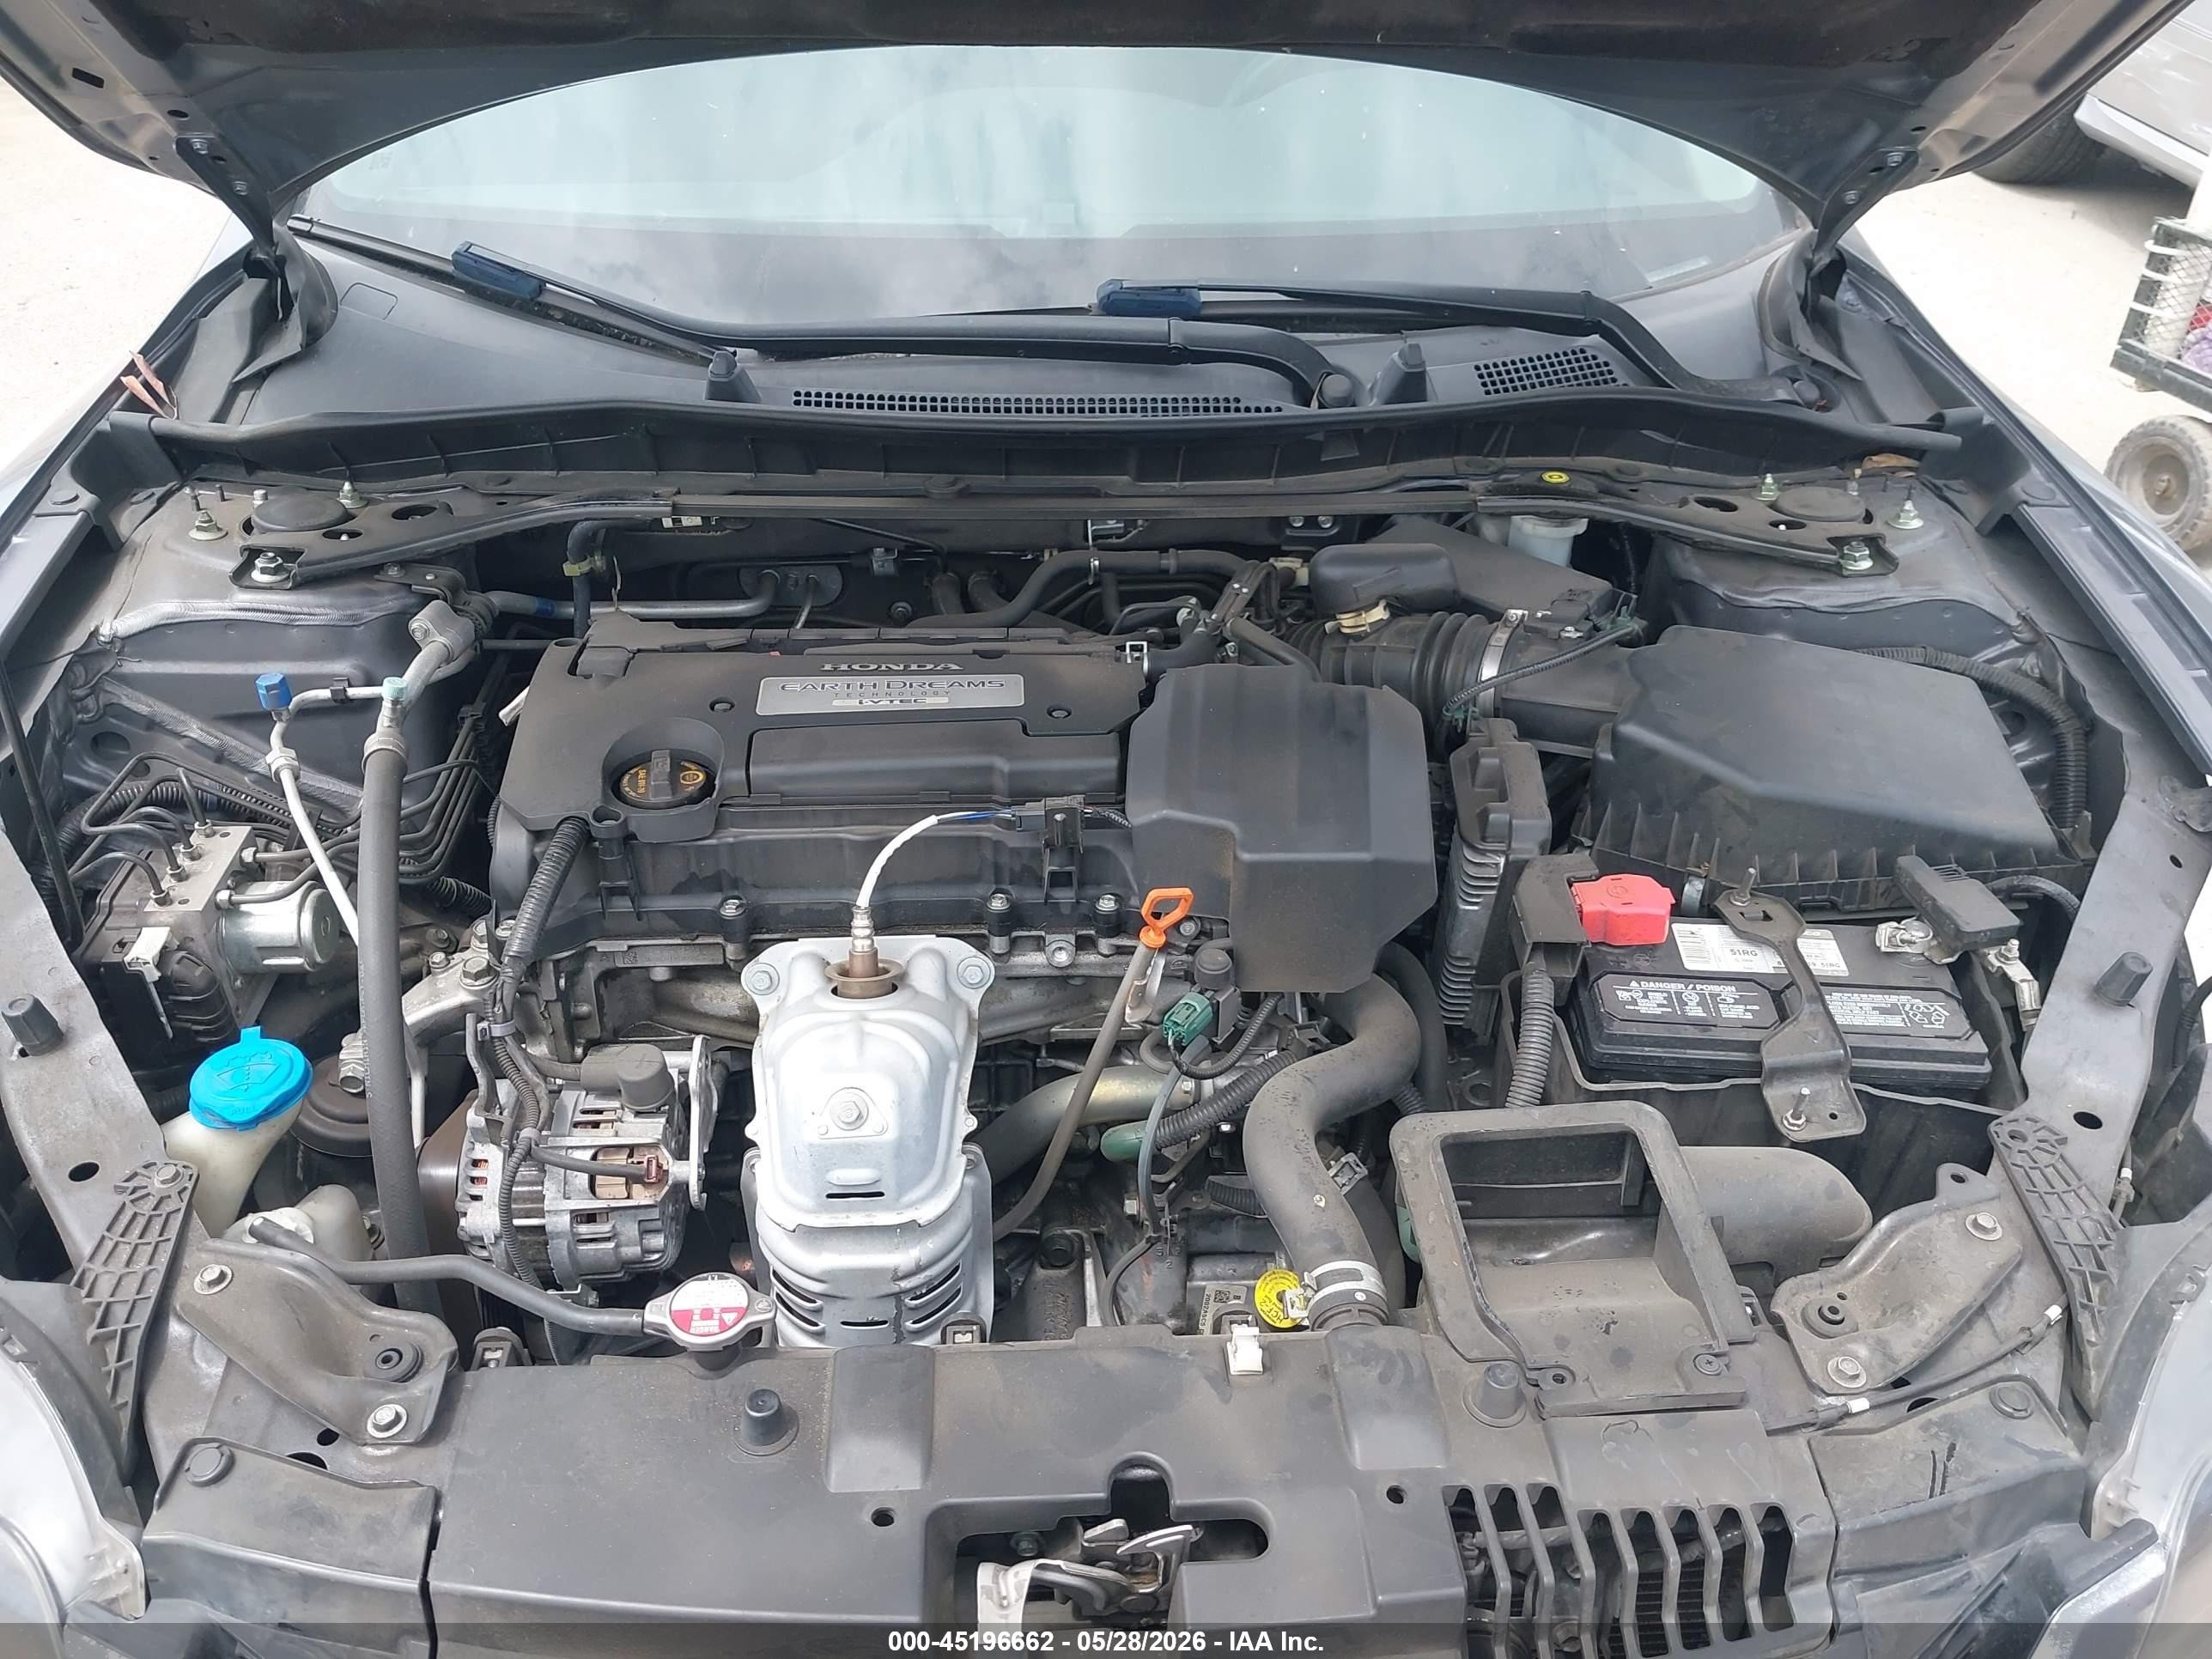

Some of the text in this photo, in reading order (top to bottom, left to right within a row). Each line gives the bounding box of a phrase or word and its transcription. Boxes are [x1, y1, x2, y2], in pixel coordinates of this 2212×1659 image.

[820, 663, 963, 672] HONDA
[780, 679, 1005, 692] EARTH DREAMS
[1729, 948, 1758, 957] 51RG
[1639, 981, 1684, 990] DANGER
[1694, 983, 1737, 993] POISON
[1259, 1297, 1284, 1324] HCF-2
